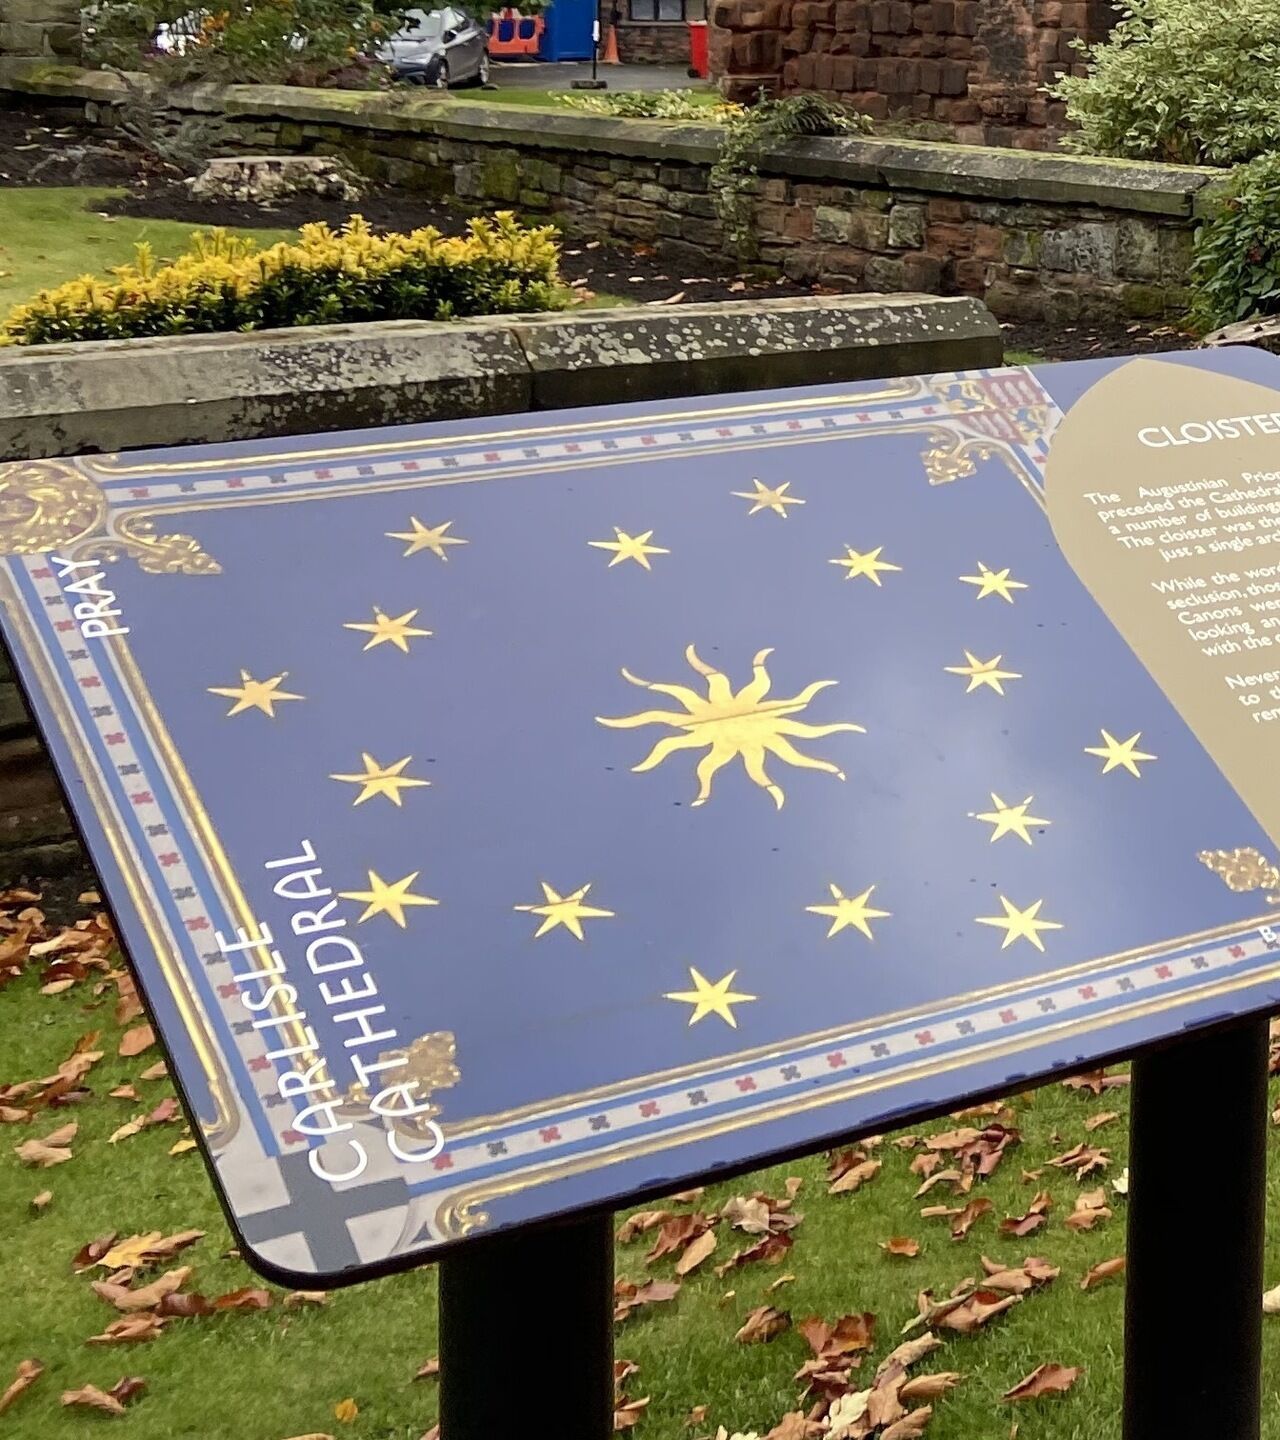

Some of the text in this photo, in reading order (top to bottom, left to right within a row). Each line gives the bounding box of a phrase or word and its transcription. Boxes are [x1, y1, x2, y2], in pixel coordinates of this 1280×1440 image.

[1083, 492, 1121, 506] The
[1138, 477, 1229, 500] Augustinian
[1097, 500, 1175, 523] preceded
[1179, 495, 1206, 509] the
[1108, 525, 1120, 535] a
[1125, 514, 1187, 532] number
[1195, 510, 1212, 522] of
[1117, 536, 1154, 550] The
[1159, 525, 1218, 544] cloister
[1222, 521, 1255, 534] was
[1159, 546, 1193, 562] just
[1194, 545, 1206, 555] a
[1209, 537, 1254, 553] single
[1151, 577, 1207, 594] While
[1211, 571, 1240, 585] the
[51, 556, 130, 638] PRAY
[1166, 589, 1248, 610] seclusion,
[1177, 606, 1243, 625] Canons
[1188, 621, 1255, 641] looking
[1202, 641, 1241, 657] with
[1243, 634, 1273, 649] the
[1239, 694, 1261, 706] to
[264, 838, 445, 1162] CATHEDRAL
[214, 920, 367, 1182] CARLISLE
